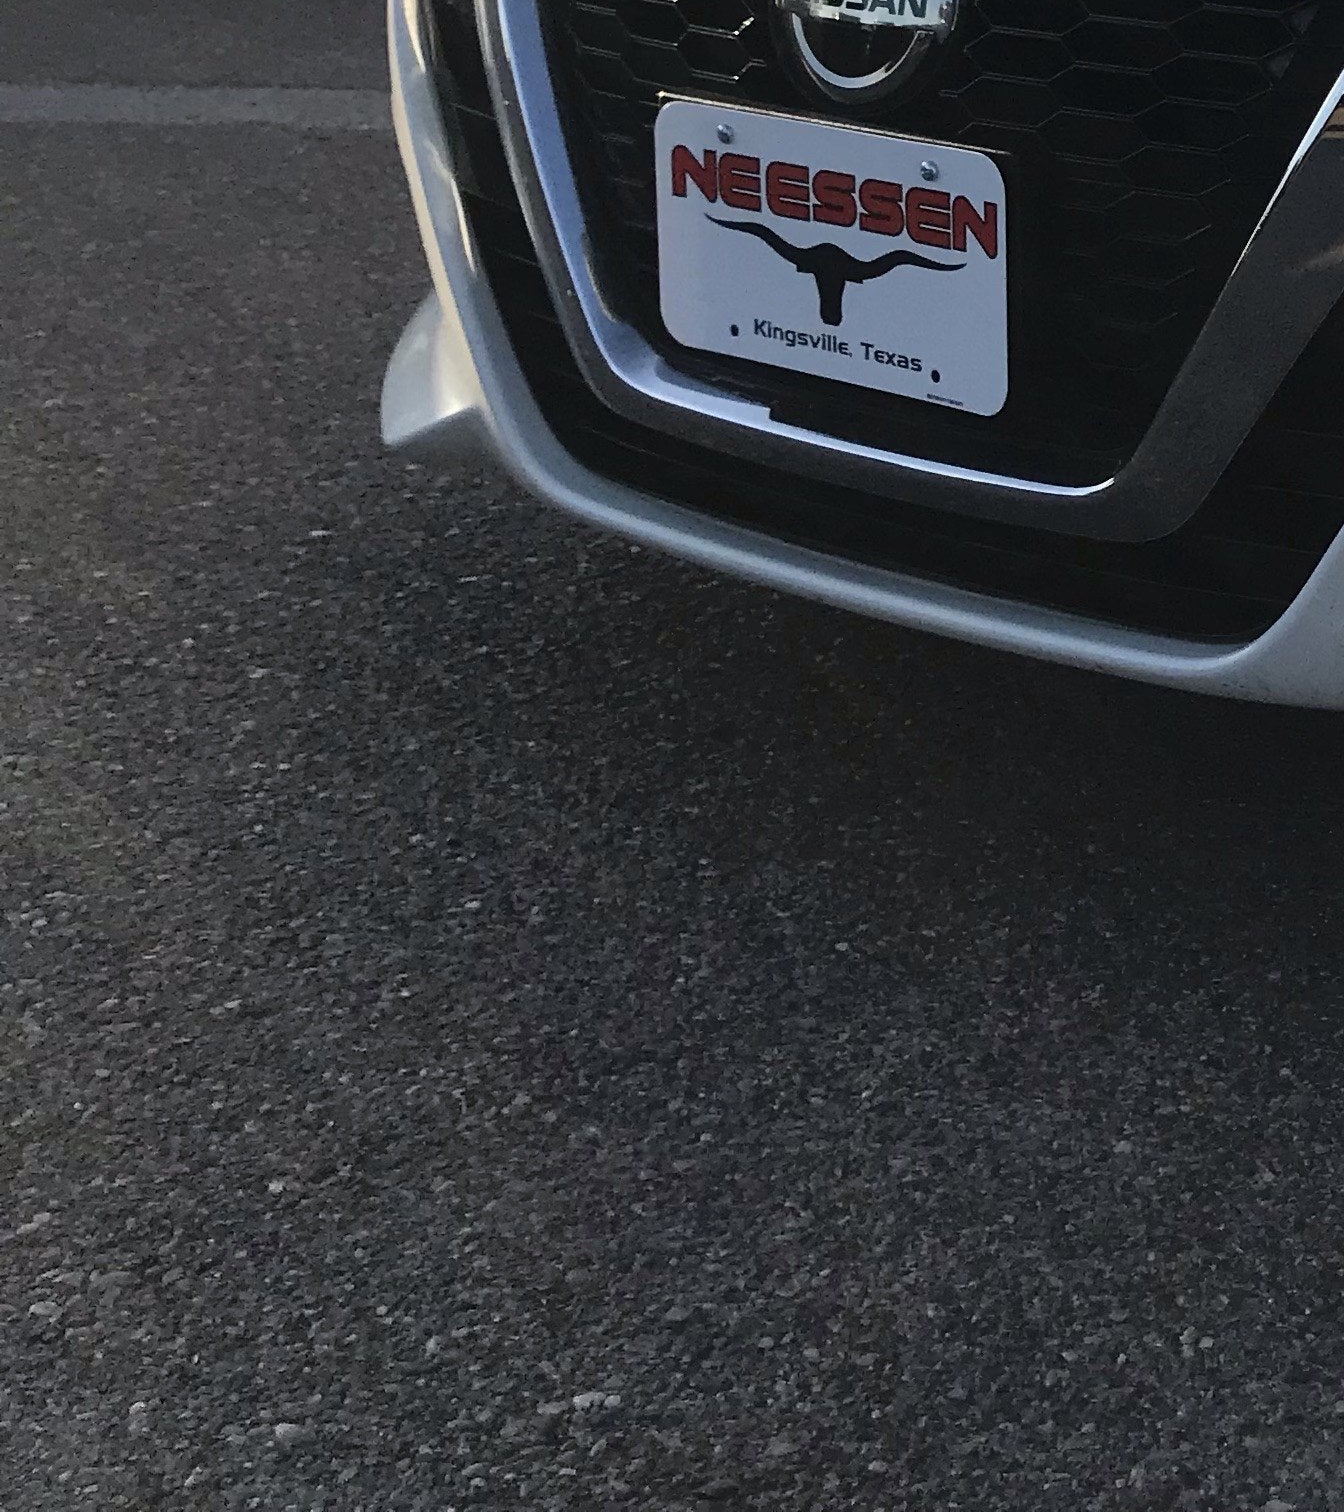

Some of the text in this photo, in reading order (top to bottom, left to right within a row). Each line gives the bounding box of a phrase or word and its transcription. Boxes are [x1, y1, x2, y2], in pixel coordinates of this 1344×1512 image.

[671, 144, 998, 260] NEESSEN
[753, 318, 923, 372] Kingsville, Texas
